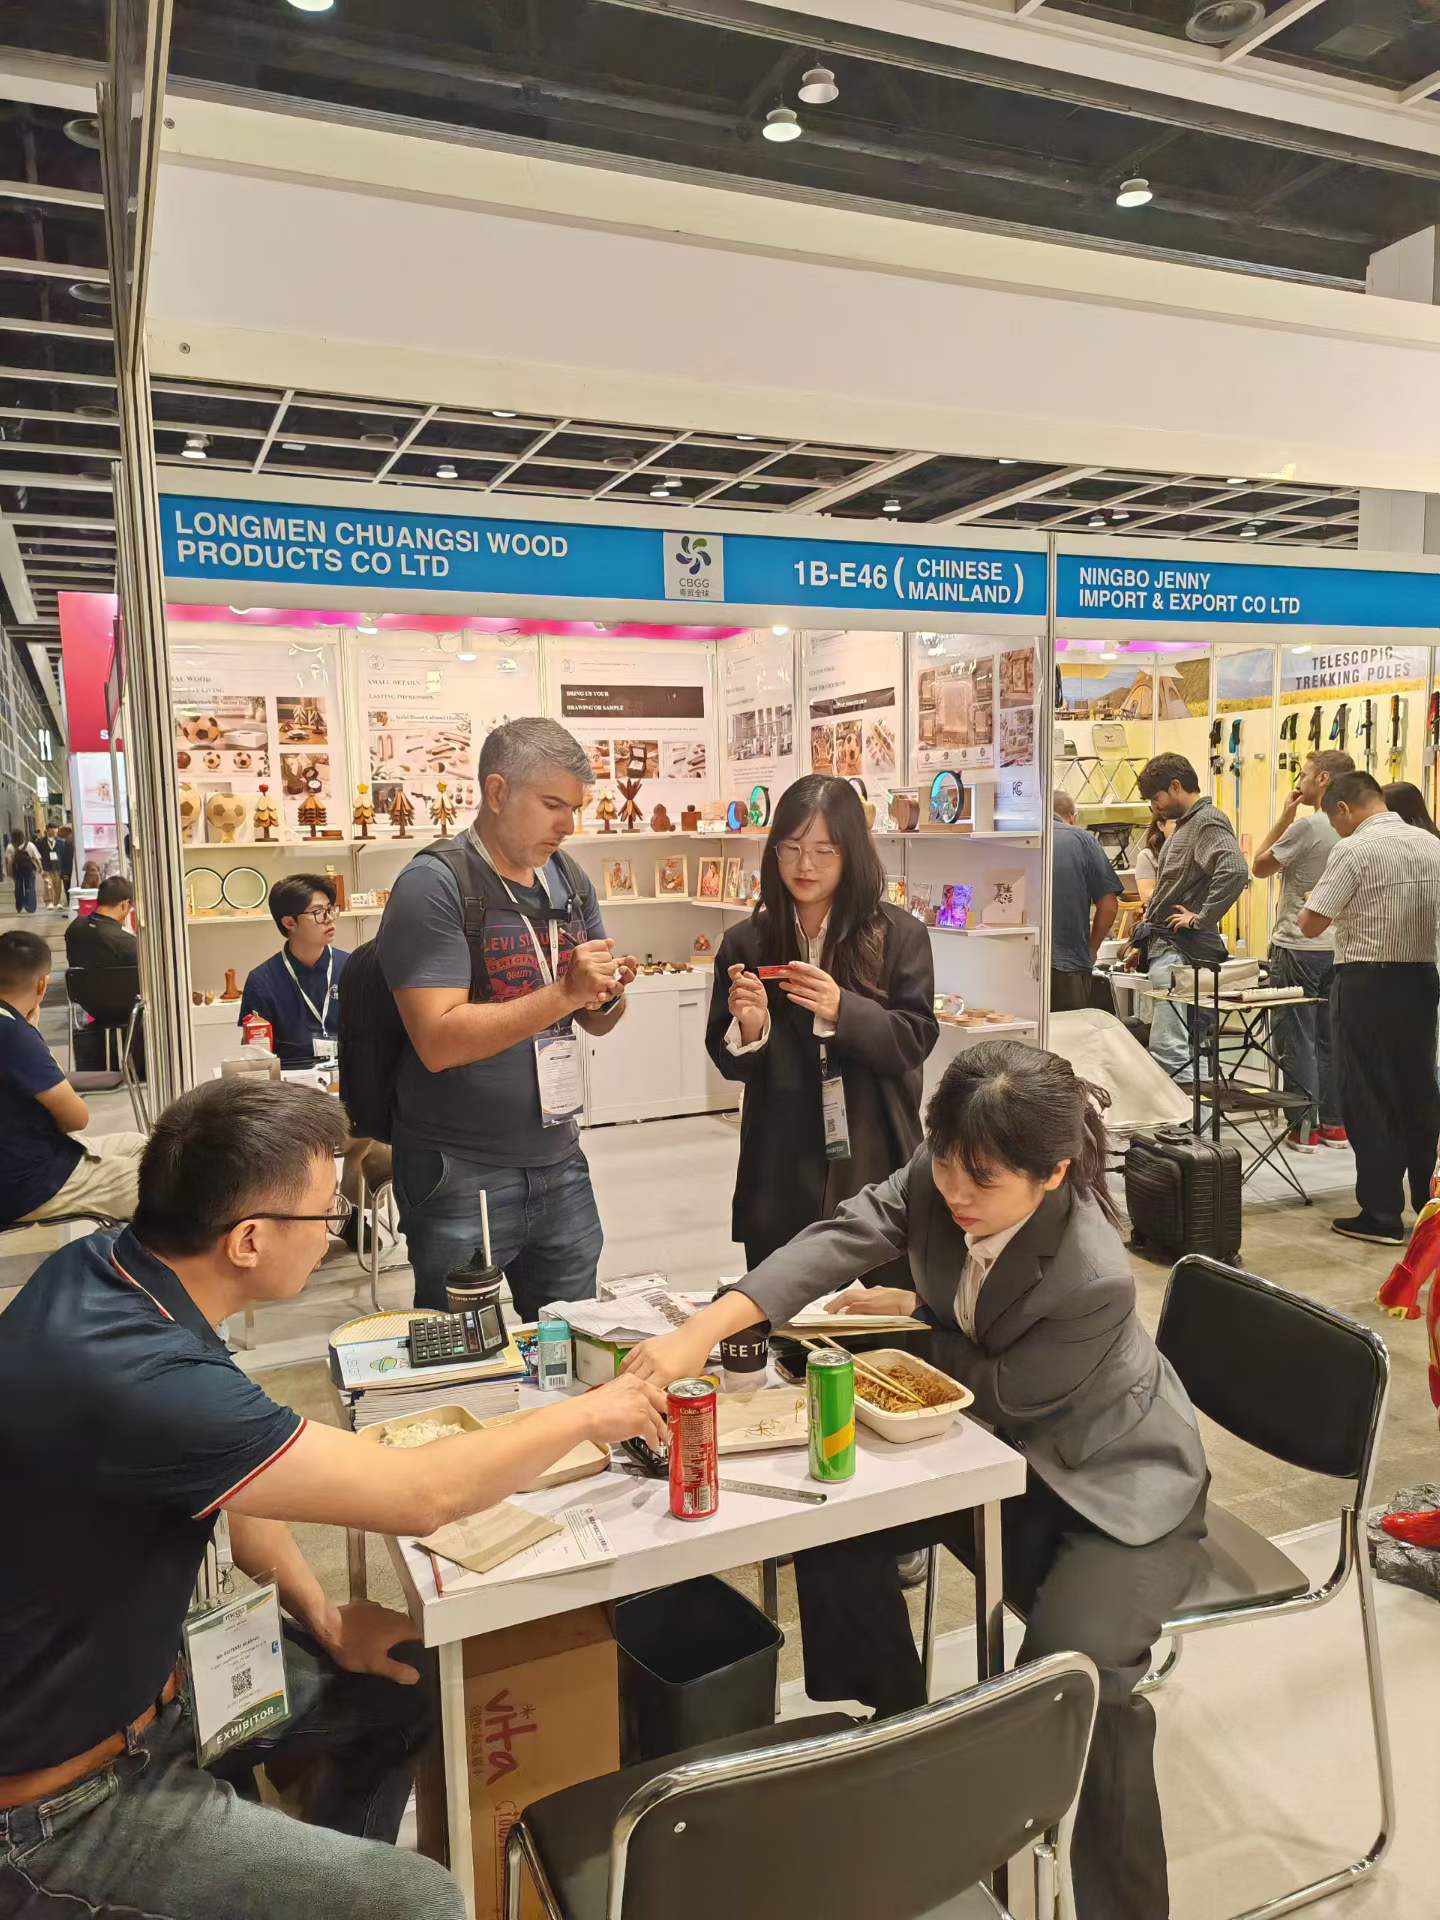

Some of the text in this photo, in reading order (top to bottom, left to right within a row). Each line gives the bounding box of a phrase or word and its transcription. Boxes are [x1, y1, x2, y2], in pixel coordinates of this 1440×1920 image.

[175, 510, 569, 558] LONGMEN CHUANGSI WOOD
[177, 539, 450, 578] PRODUCTS CO LTD
[679, 578, 710, 588] CBGG
[793, 560, 888, 589] 1B-E46
[916, 557, 1003, 581] CHINESE
[1079, 567, 1211, 590] NINGBO JENNY
[908, 580, 1012, 604] MAINLAND
[1079, 588, 1300, 614] IMPORT & EXPORT CO LTD
[1312, 646, 1393, 670] TELESCOPIC
[1295, 662, 1411, 690] TREKKING POLES
[680, 1407, 696, 1416] Coke
[216, 1706, 274, 1745] EXHIBITOR
[485, 1688, 538, 1787] vita
